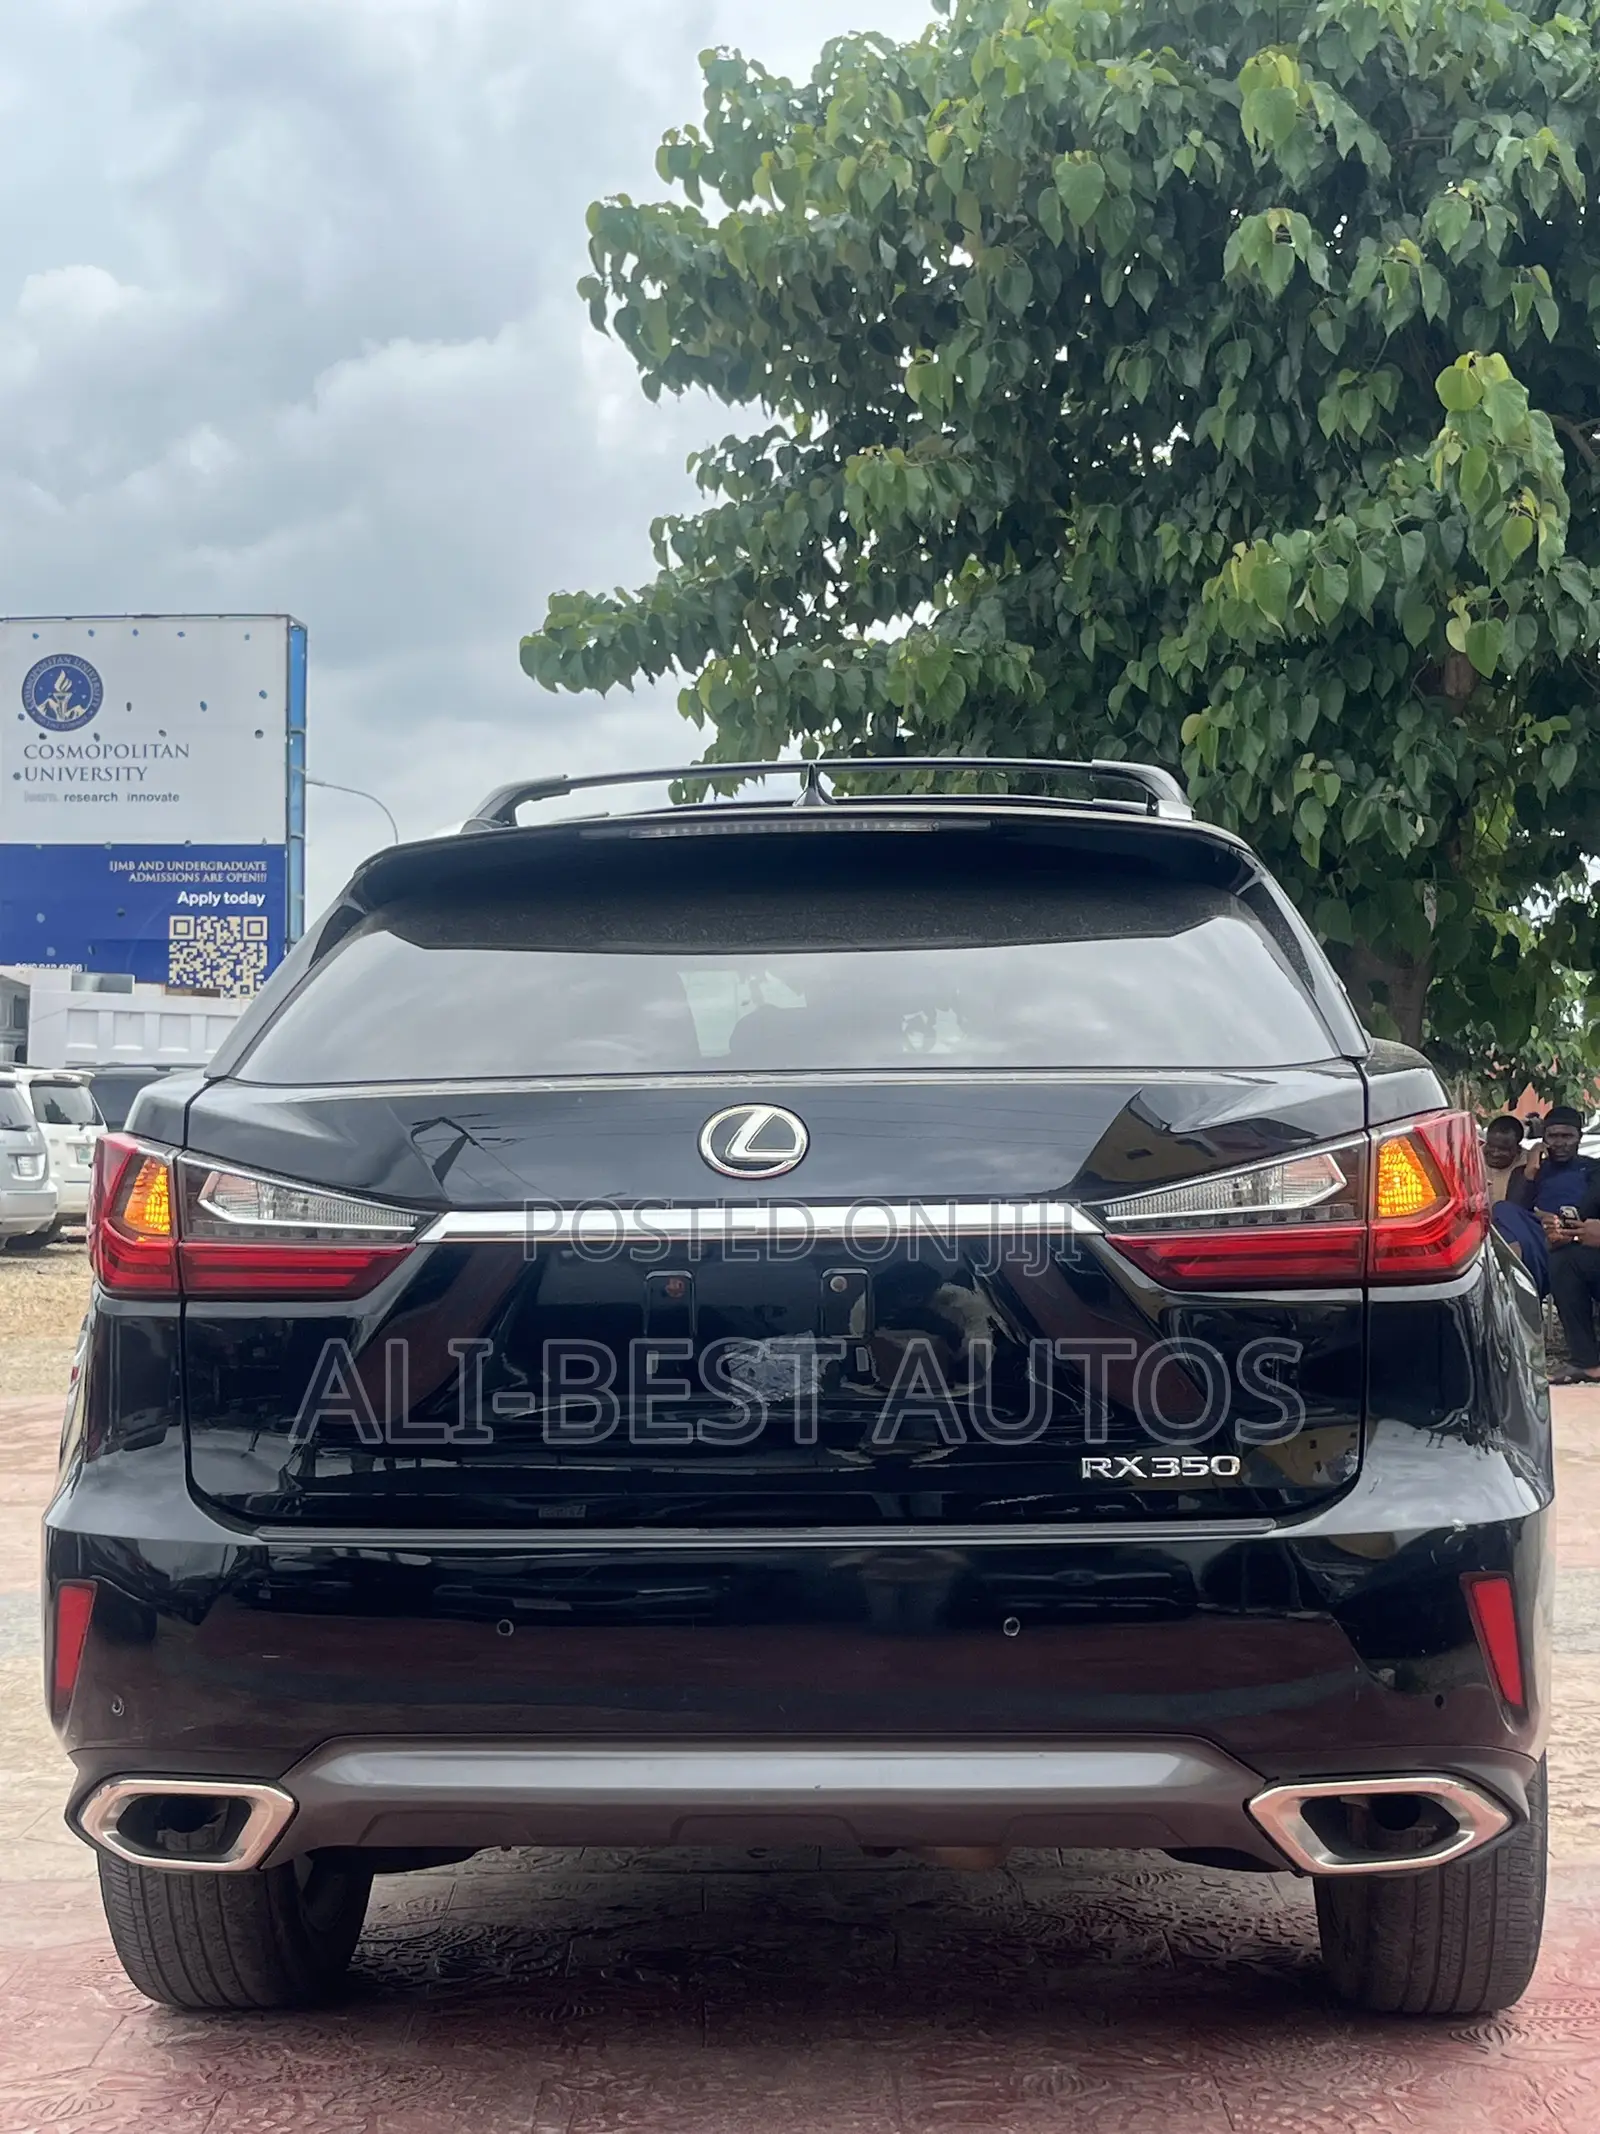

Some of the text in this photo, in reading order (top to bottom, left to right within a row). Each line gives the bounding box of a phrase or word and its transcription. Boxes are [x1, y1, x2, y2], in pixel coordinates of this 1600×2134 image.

[23, 743, 190, 760] COSMOPOLITAN
[24, 766, 148, 782] UNIVERSITY
[64, 791, 118, 802] research
[127, 791, 180, 802] innovate
[109, 860, 267, 873] IJMB AND UNDERGRADUATE
[129, 872, 200, 883] ADMISSIONS
[202, 872, 224, 883] ARE
[177, 891, 266, 907] Apply today
